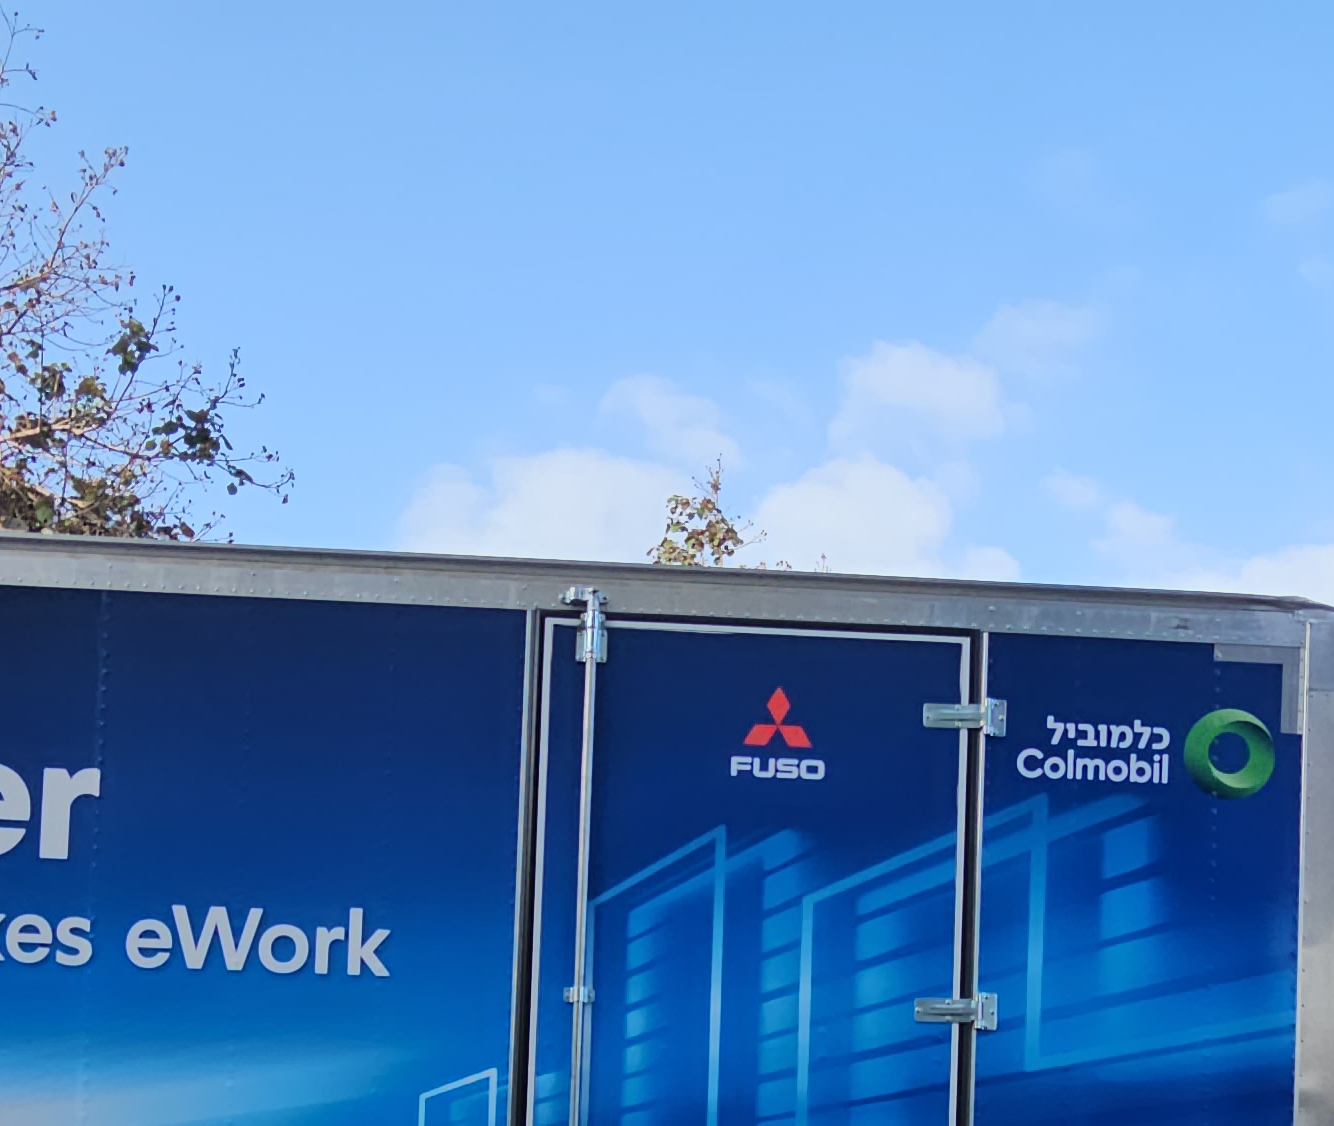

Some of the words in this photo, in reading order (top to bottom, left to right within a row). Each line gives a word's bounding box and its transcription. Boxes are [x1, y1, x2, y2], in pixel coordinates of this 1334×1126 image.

[1046, 715, 1170, 750] כלמוביל
[730, 755, 825, 780] FUSO
[1016, 748, 1169, 784] Colmobil
[125, 904, 390, 977] eWork
